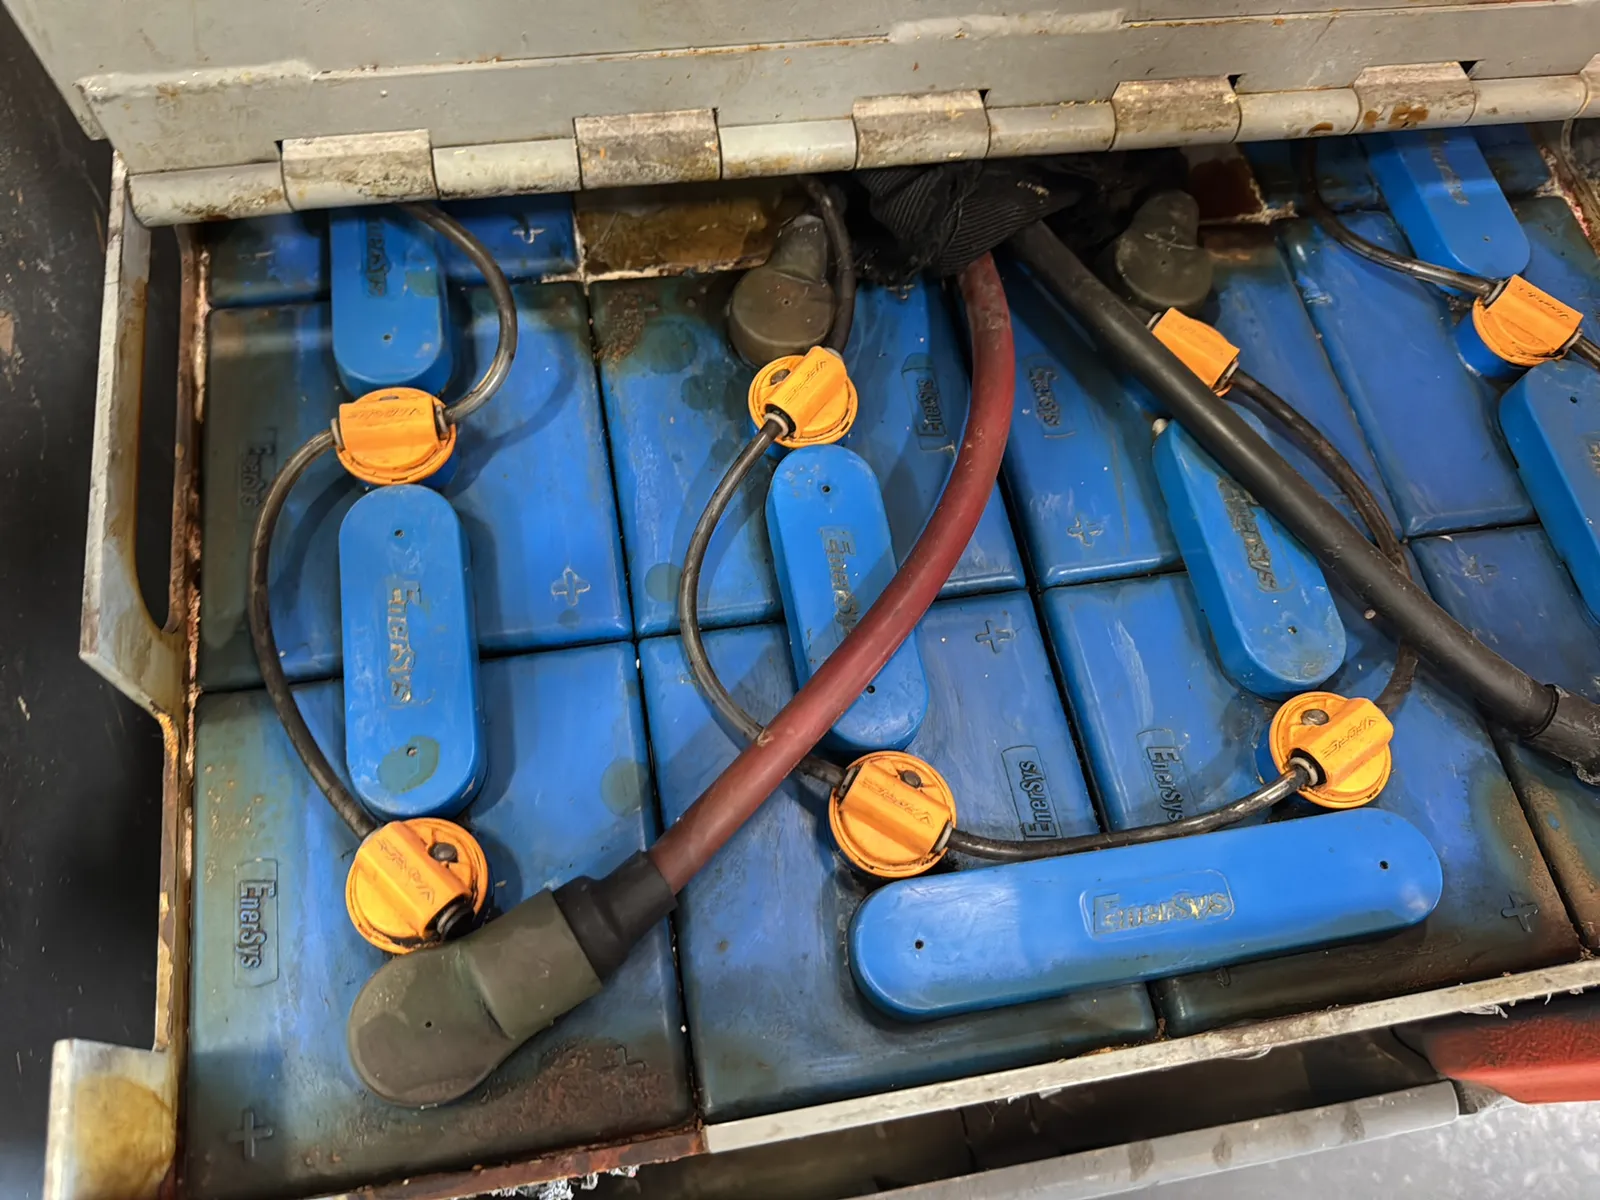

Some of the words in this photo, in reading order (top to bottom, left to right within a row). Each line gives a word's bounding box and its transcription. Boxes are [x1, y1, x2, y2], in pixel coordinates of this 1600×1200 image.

[1019, 760, 1058, 838] EnerSys
[1147, 746, 1184, 821] EnerSys
[236, 880, 277, 969] EnerSys
[1093, 891, 1230, 935] EnerSys
